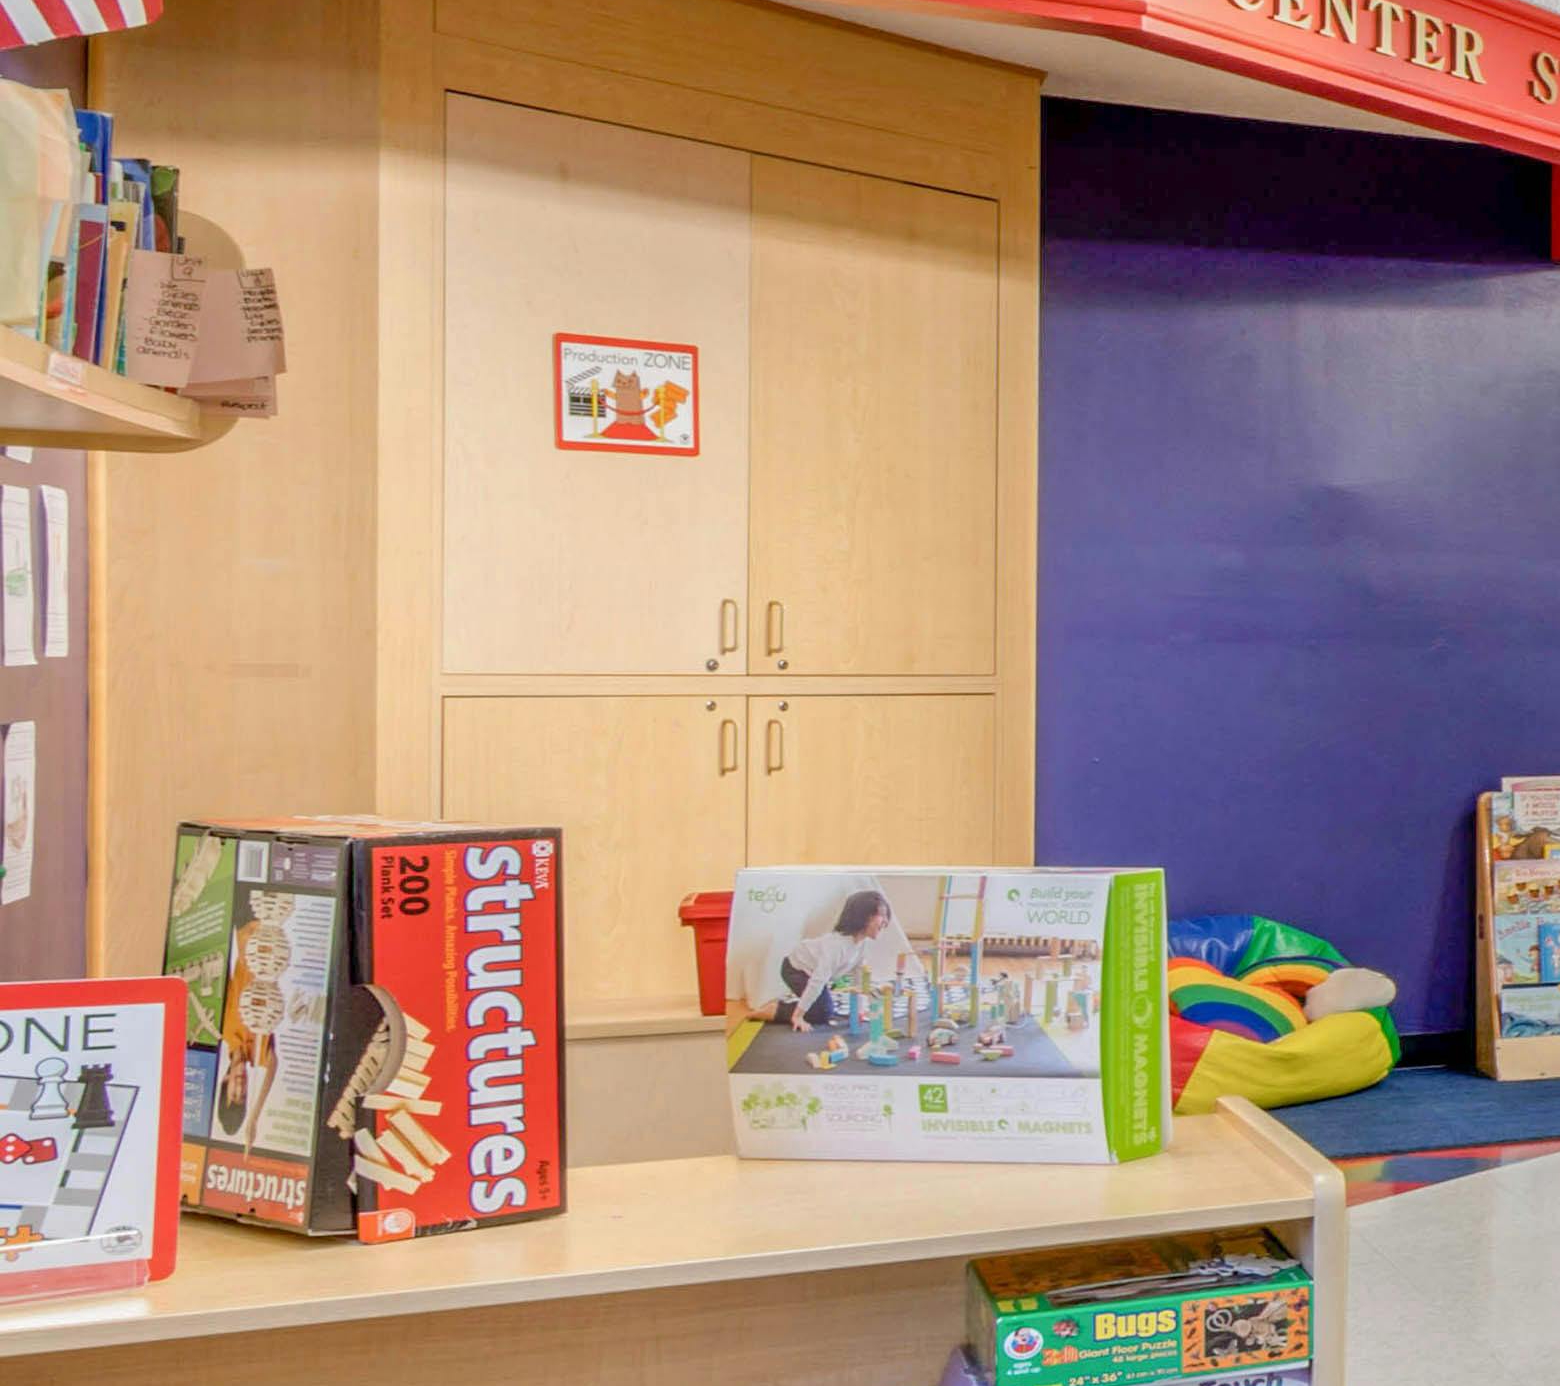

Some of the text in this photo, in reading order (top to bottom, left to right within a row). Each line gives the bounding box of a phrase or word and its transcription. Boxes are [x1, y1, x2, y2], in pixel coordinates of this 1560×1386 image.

[563, 347, 691, 371] Production ZONE
[399, 855, 431, 916] 200
[534, 858, 549, 890] KEVA
[380, 855, 394, 920] Plank Set
[747, 885, 787, 913] tegu
[1029, 887, 1093, 903] Build your
[1025, 909, 1091, 926] WORLD
[924, 1087, 945, 1105] 42
[1131, 1034, 1149, 1146] MAGNETS
[921, 1119, 1093, 1134] INVISIBLE MAGNETS
[538, 1160, 550, 1183] Ages
[1093, 1310, 1178, 1342] Bugs
[1079, 1340, 1178, 1359] Giant Floor Puzzle
